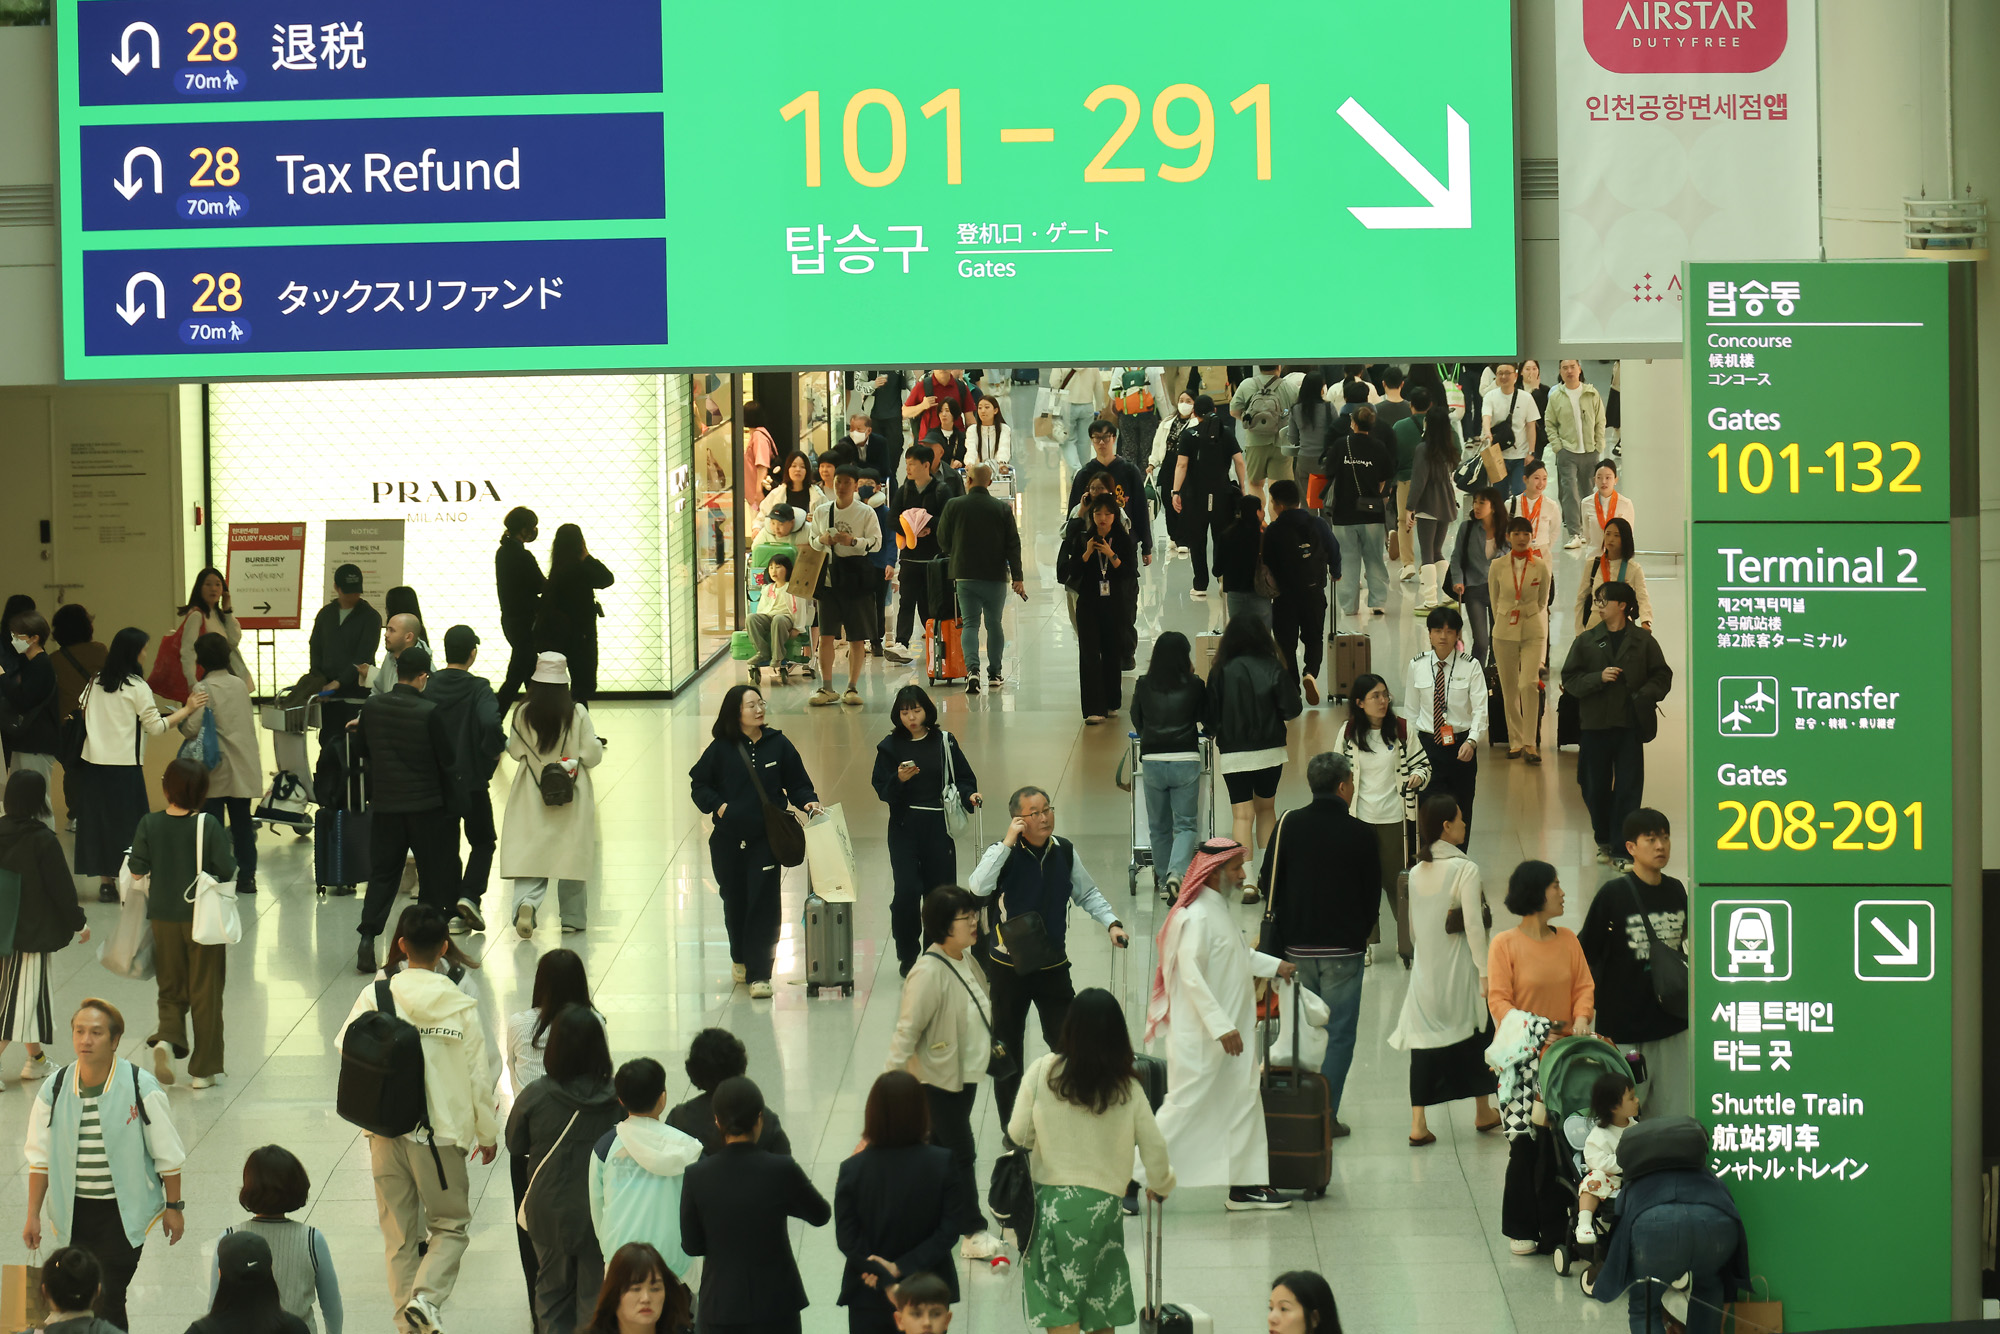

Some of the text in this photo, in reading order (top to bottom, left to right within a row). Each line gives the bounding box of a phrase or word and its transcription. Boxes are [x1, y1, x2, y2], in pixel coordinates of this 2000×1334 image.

[1616, 1, 1756, 30] AIRSTAR
[187, 21, 366, 70] 28 退税
[185, 74, 221, 89] 70m
[1586, 94, 1787, 121] 인천공항면세점앱
[189, 147, 519, 194] 28 Tax Refund
[187, 199, 223, 214] 70m
[786, 224, 929, 274] 탑승구
[958, 259, 1016, 278] Gates
[192, 272, 563, 315] 28 タックスリファンド
[1708, 280, 1801, 317] 탑승동
[190, 325, 226, 340] 70m
[1708, 333, 1792, 348] Concourse
[1708, 353, 1755, 368] 候机楼
[1708, 373, 1771, 386] コンコース
[1708, 407, 1781, 430] Gates
[1708, 441, 1922, 494] 101-132
[372, 480, 502, 503] PRADA
[406, 512, 468, 522] MILANO
[1718, 547, 1918, 583] Terminal 2
[1718, 598, 1805, 613] 제2여객터미널
[1717, 616, 1782, 631] 2号航站楼
[1717, 633, 1847, 648] 第2旅客ターミナル
[1791, 685, 1900, 710] Transfer
[1717, 763, 1787, 786] Gates
[1717, 800, 1922, 851] 208-291
[1711, 1002, 1834, 1033] 셔틀트레인
[1714, 1040, 1792, 1071] 타는 곳
[1712, 1092, 1864, 1116] Shuttle Train
[1711, 1123, 1820, 1152] 航站列车
